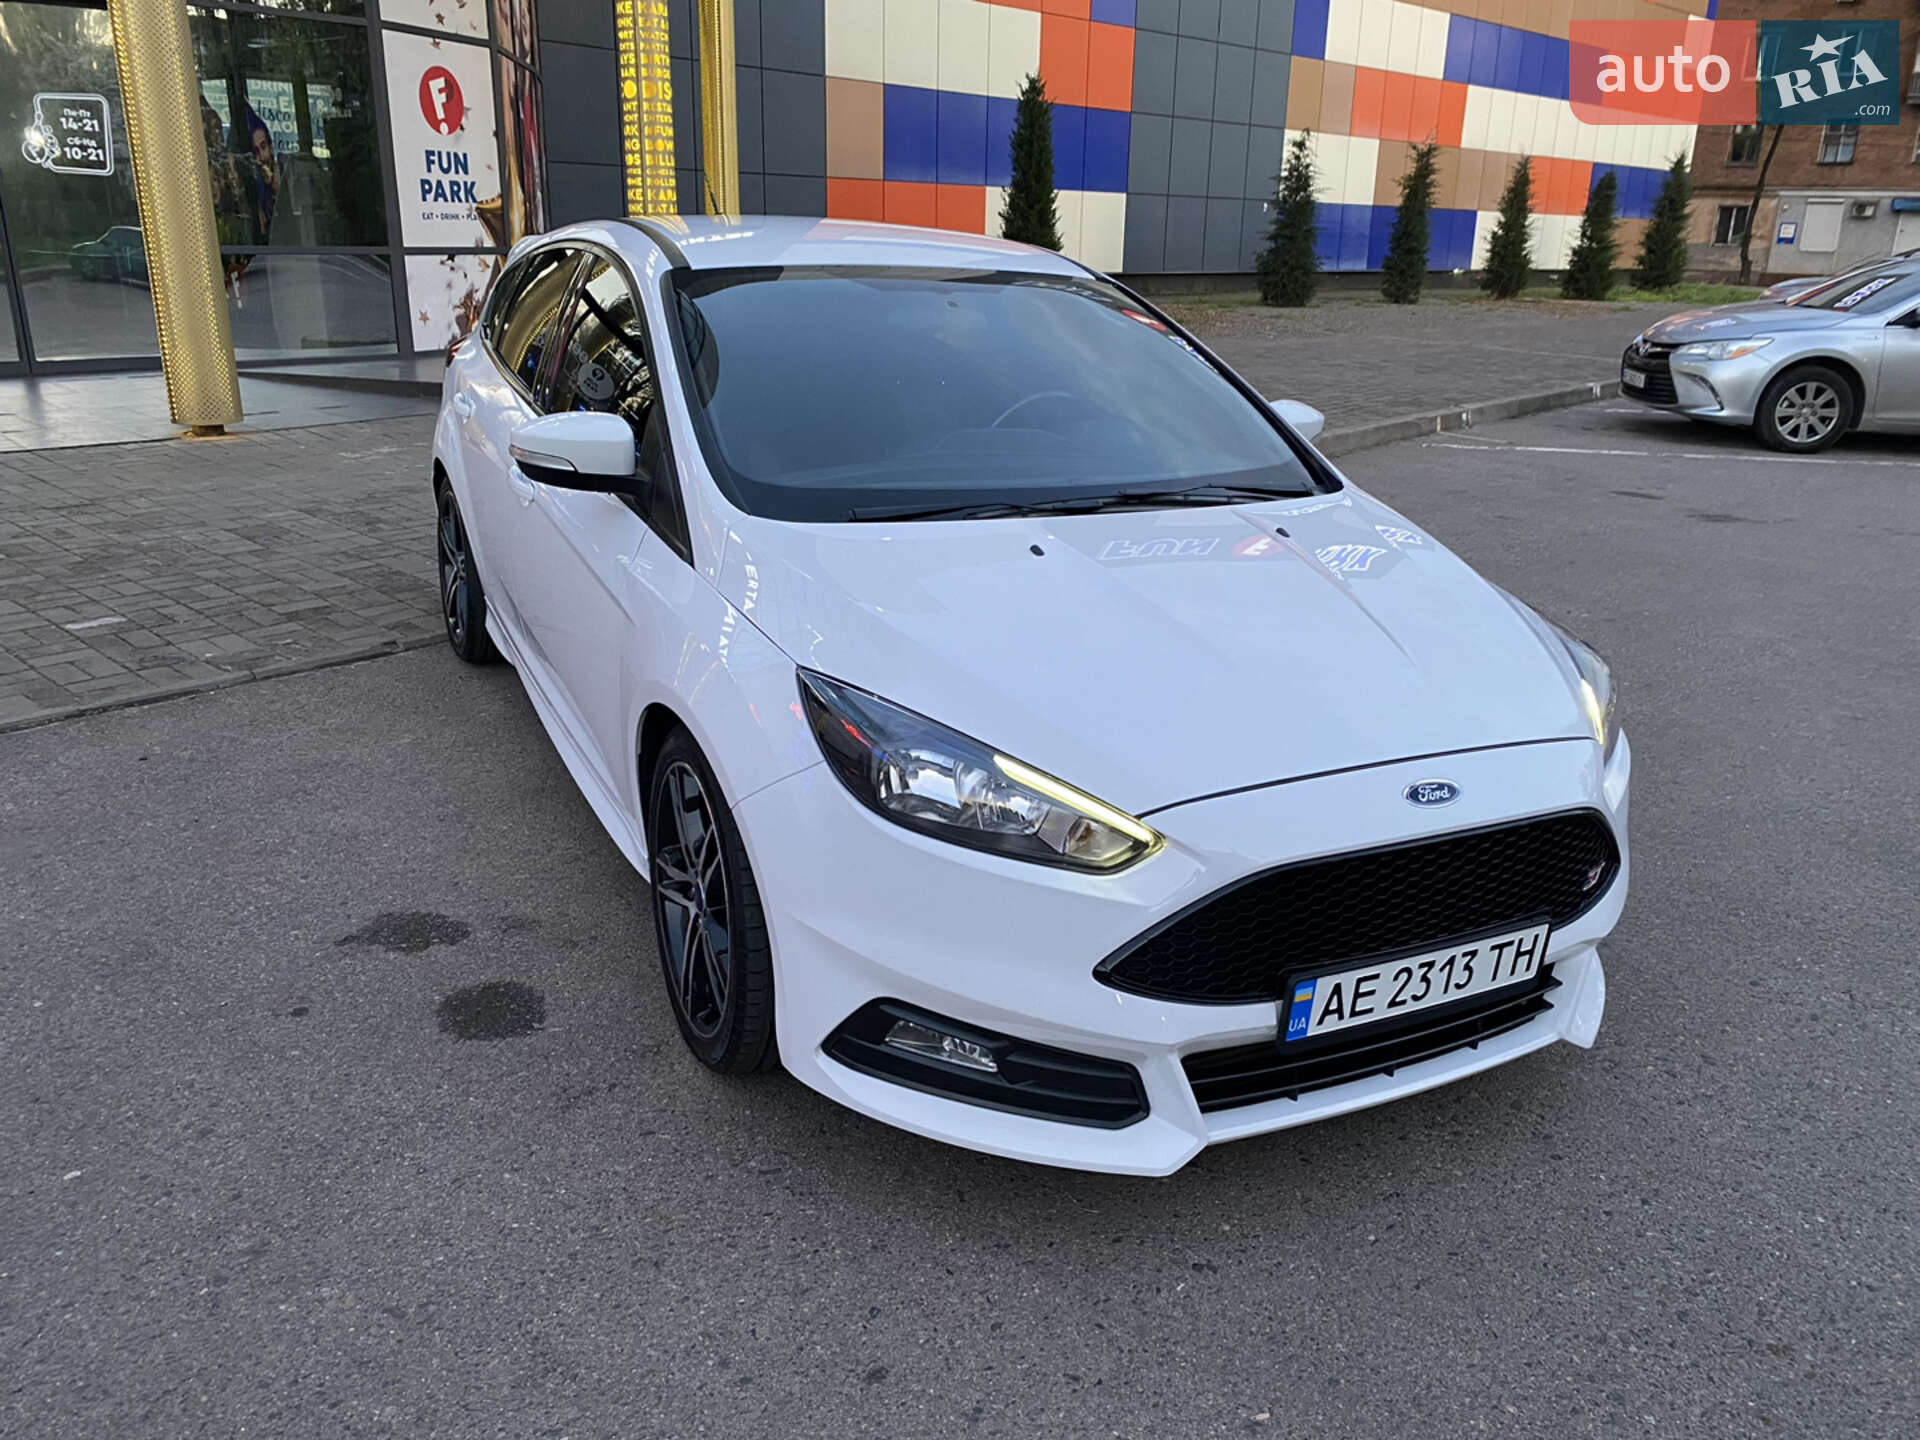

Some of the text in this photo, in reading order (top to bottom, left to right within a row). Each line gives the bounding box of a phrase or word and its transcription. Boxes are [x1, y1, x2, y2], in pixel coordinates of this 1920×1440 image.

[59, 117, 100, 132] 14-21
[63, 146, 105, 162] 10-21
[425, 149, 470, 176] FUN
[420, 178, 478, 204] PARK
[422, 212, 434, 220] EAT
[466, 213, 478, 221] PLA
[1418, 783, 1451, 802] Ford
[1288, 933, 1541, 1032] UA AE 2313 TH
